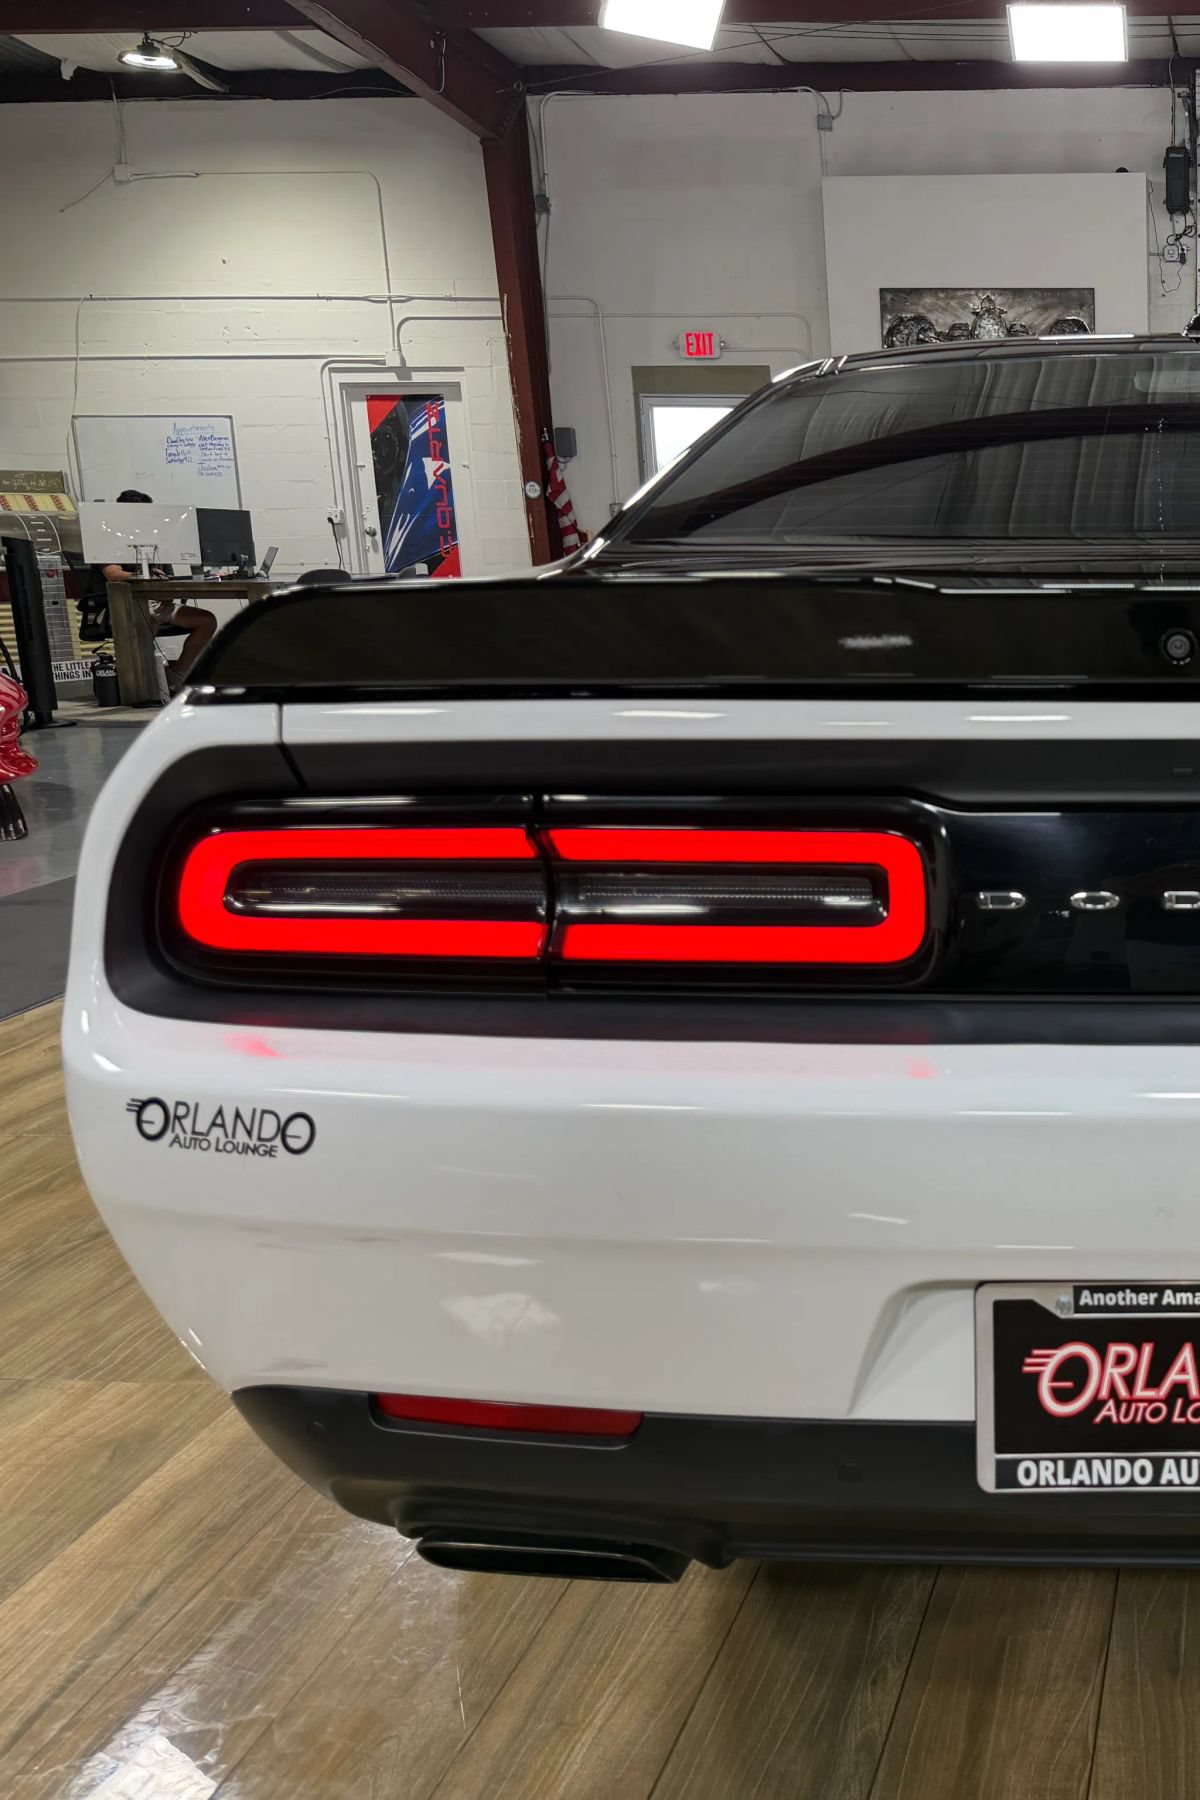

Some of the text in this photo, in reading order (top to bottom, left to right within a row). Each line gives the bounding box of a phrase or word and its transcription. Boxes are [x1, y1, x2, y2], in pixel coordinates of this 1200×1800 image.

[685, 333, 714, 356] EXIT
[53, 661, 90, 672] HE LITTLE
[54, 670, 92, 680] HINGS IN
[134, 1096, 317, 1156] ORLANDO
[169, 1133, 278, 1158] AUTO LOUNGE
[1079, 1288, 1158, 1306] Another
[1093, 1399, 1168, 1424] AUTO
[1016, 1458, 1154, 1488] ORLANDO
